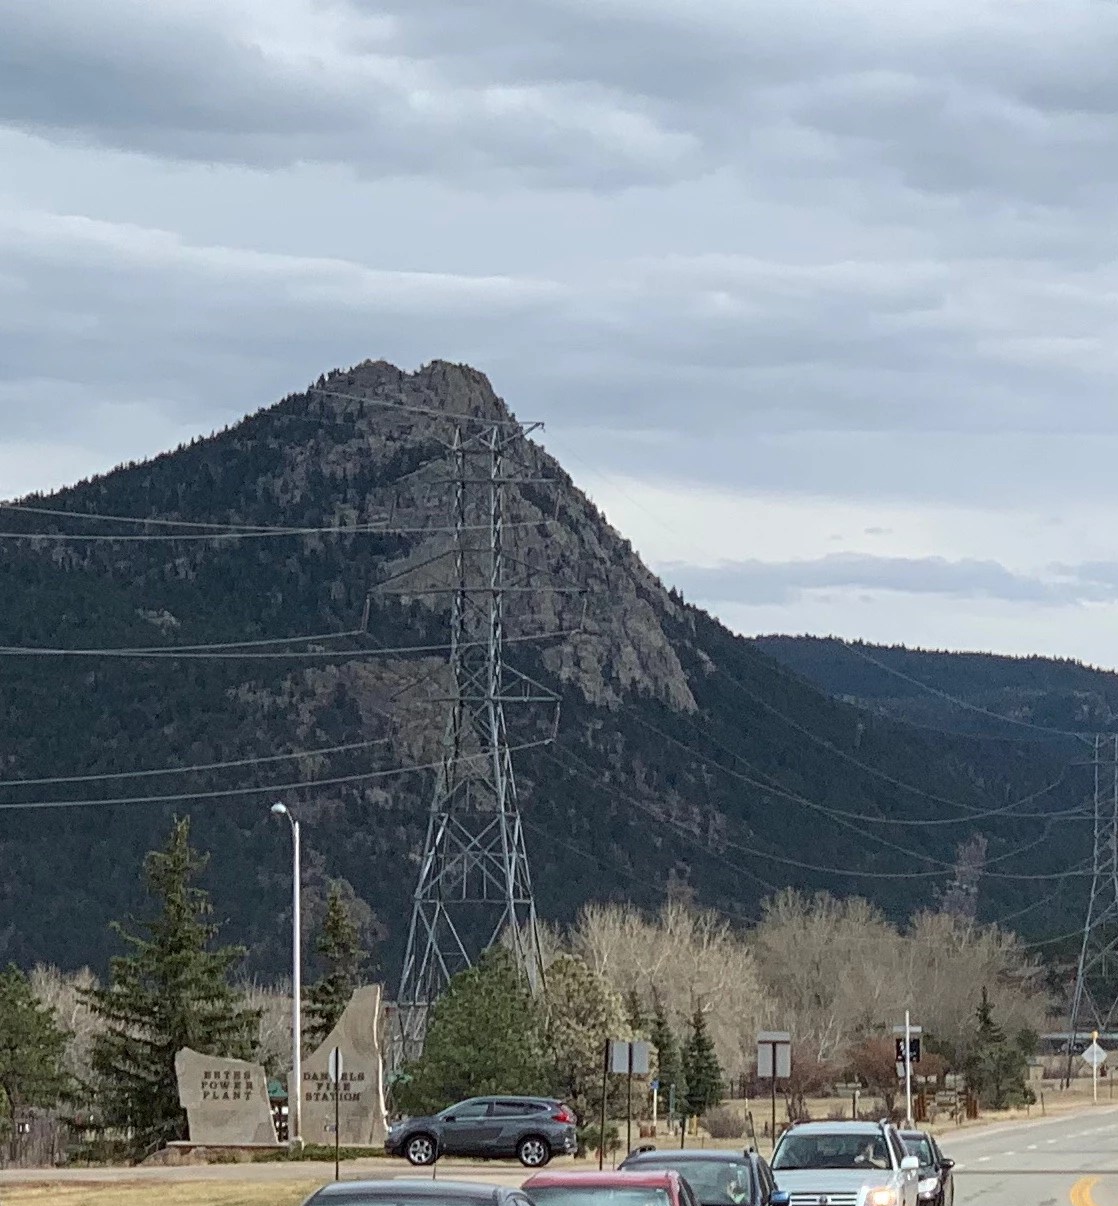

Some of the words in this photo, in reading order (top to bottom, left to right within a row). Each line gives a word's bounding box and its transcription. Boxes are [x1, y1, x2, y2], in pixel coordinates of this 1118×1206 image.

[303, 1072, 365, 1081] DANELS
[201, 1081, 253, 1090] POWER
[203, 1091, 252, 1101] PLANT
[305, 1092, 361, 1102] STATION
